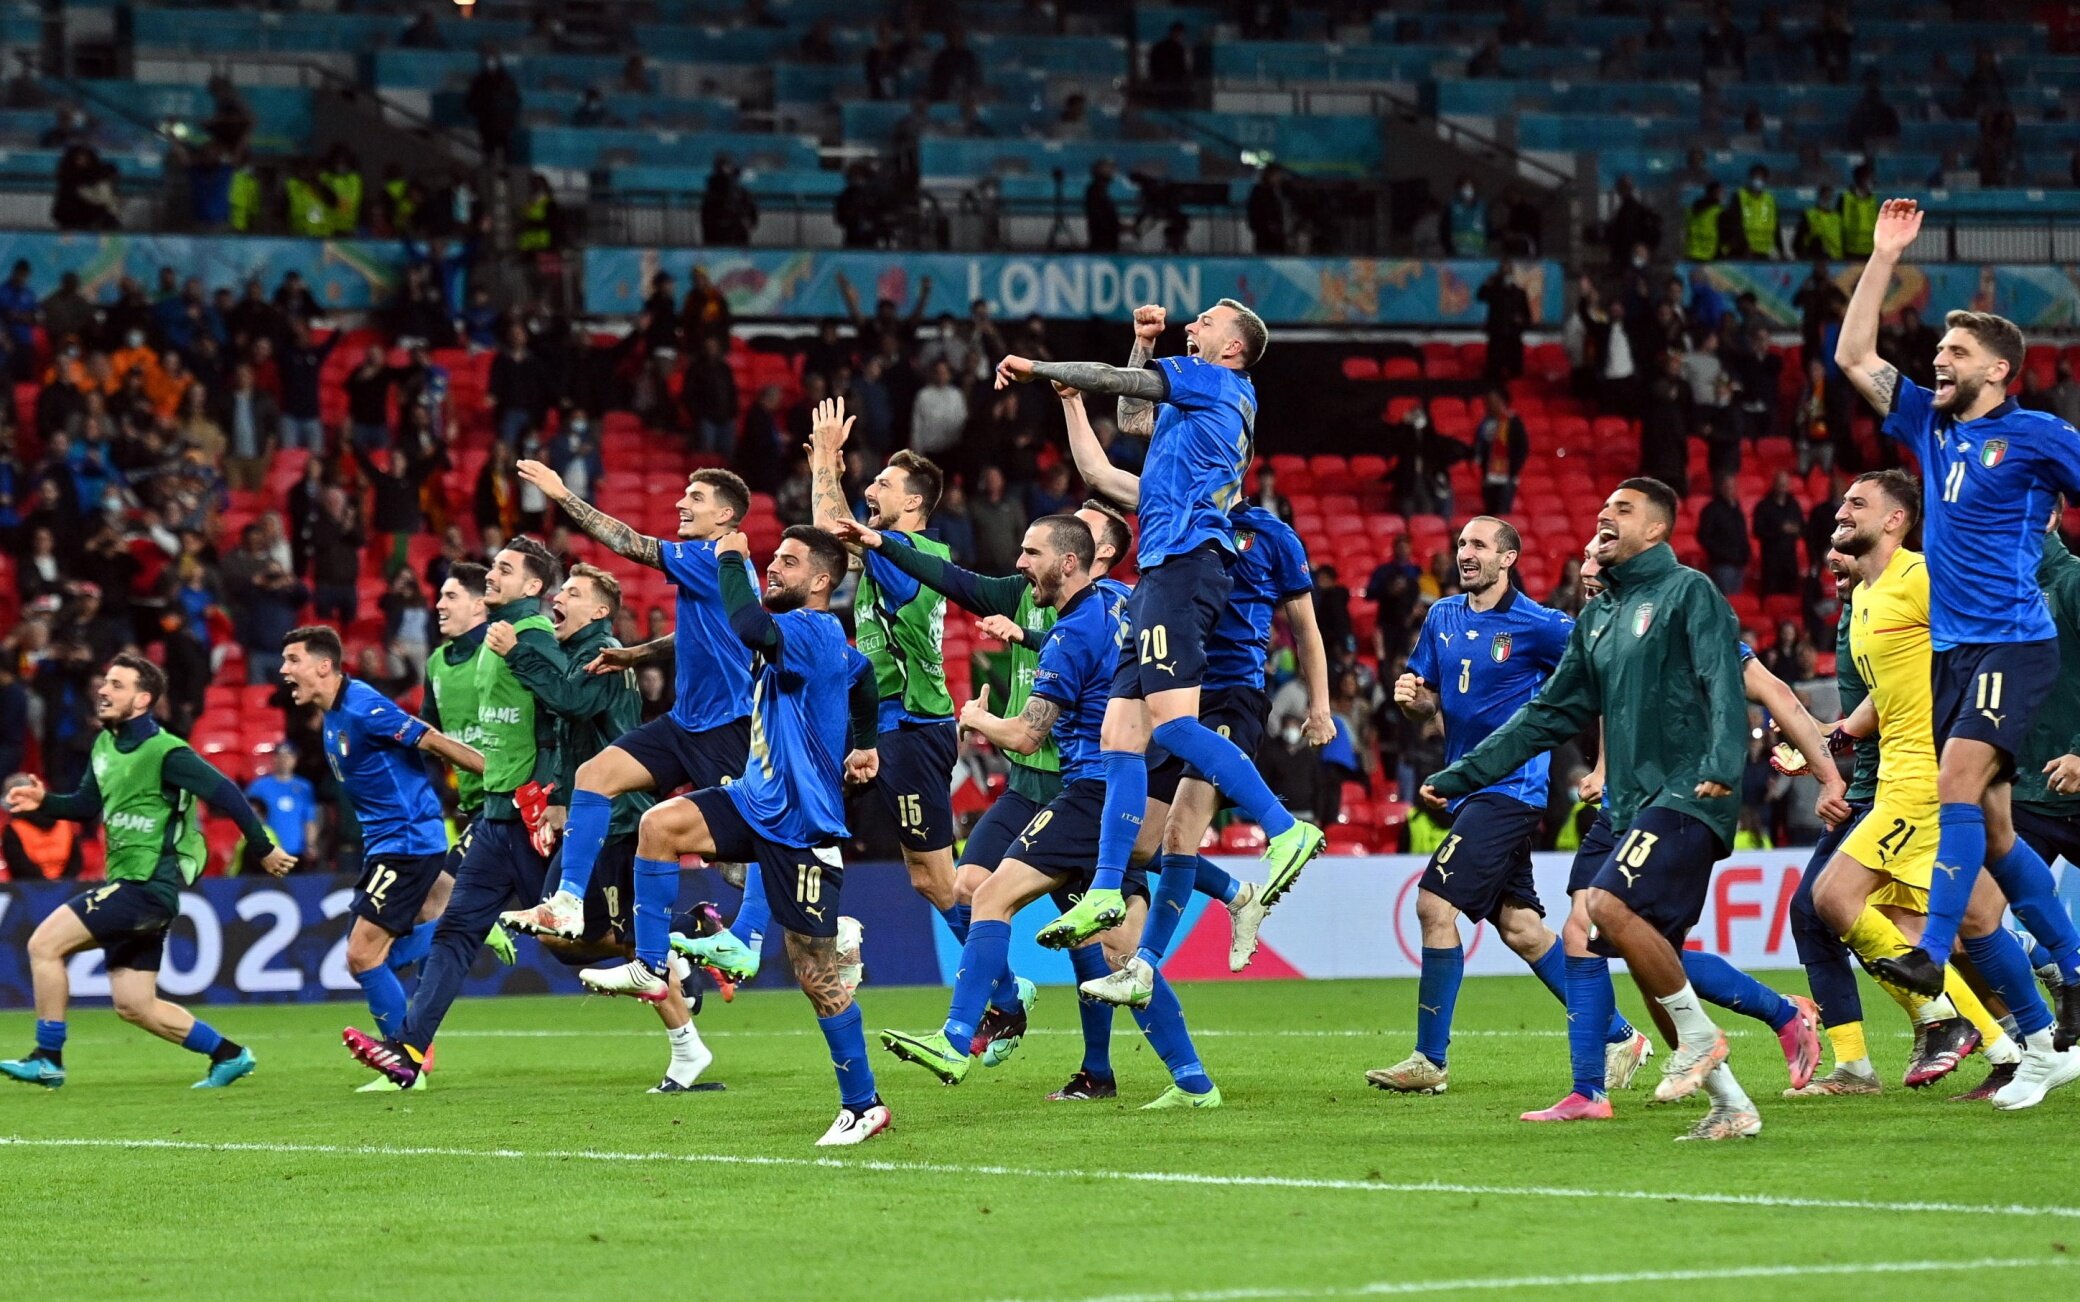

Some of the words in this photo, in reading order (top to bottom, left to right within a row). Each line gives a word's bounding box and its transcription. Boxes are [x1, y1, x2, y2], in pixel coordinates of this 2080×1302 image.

[968, 261, 1200, 315] LONDON
[1942, 461, 1966, 503] 11
[1140, 624, 1169, 666] 20
[1458, 658, 1472, 694] 3
[1857, 653, 1878, 690] 21
[1976, 672, 2003, 709] 11
[897, 794, 923, 827] 15
[1437, 833, 1463, 865] 3
[1614, 828, 1659, 868] 13
[1876, 817, 1917, 856] 21
[365, 863, 399, 900] 12
[796, 863, 823, 904] 10
